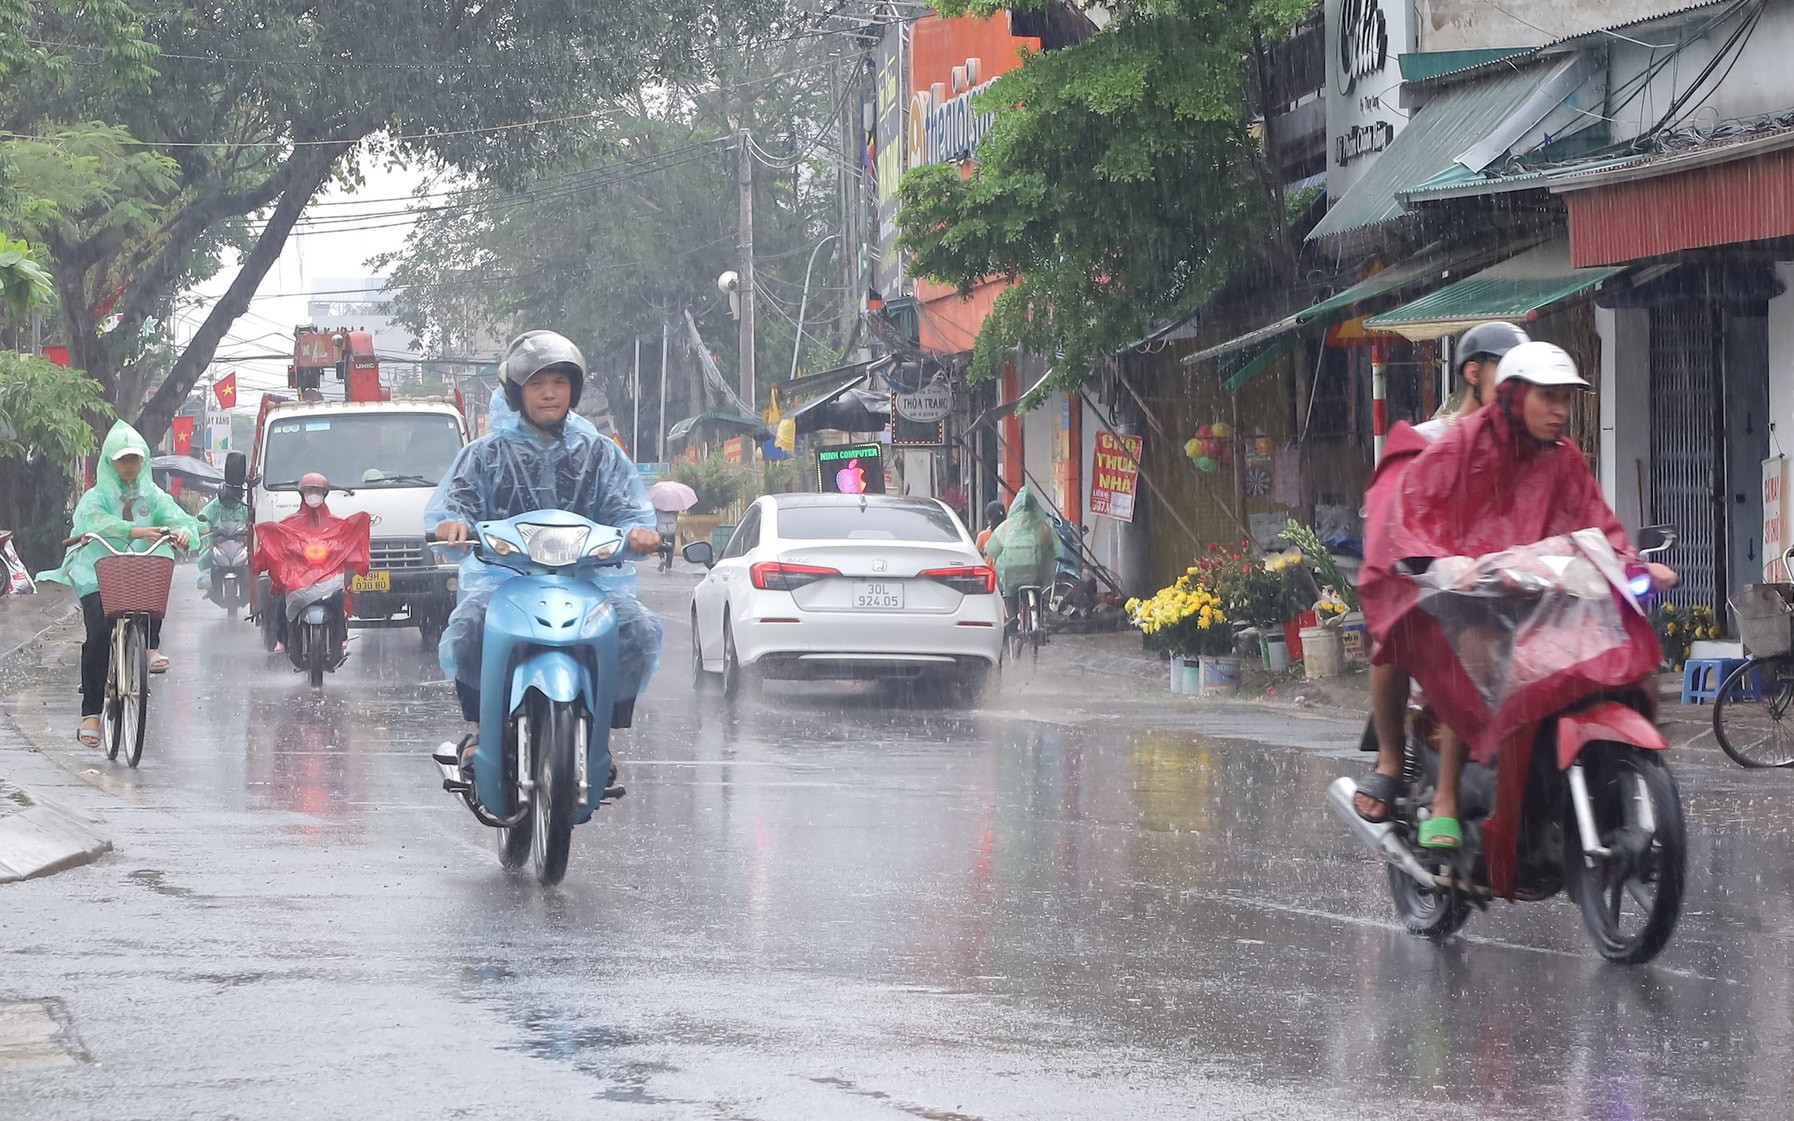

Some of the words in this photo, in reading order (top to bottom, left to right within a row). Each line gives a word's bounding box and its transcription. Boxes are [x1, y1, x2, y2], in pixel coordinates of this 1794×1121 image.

[355, 362, 375, 370] UNIC
[925, 398, 948, 410] TRANG
[820, 452, 838, 461] NINH
[839, 448, 878, 459] COMPUTER
[867, 584, 889, 595] 30L
[858, 596, 899, 607] 924.05
